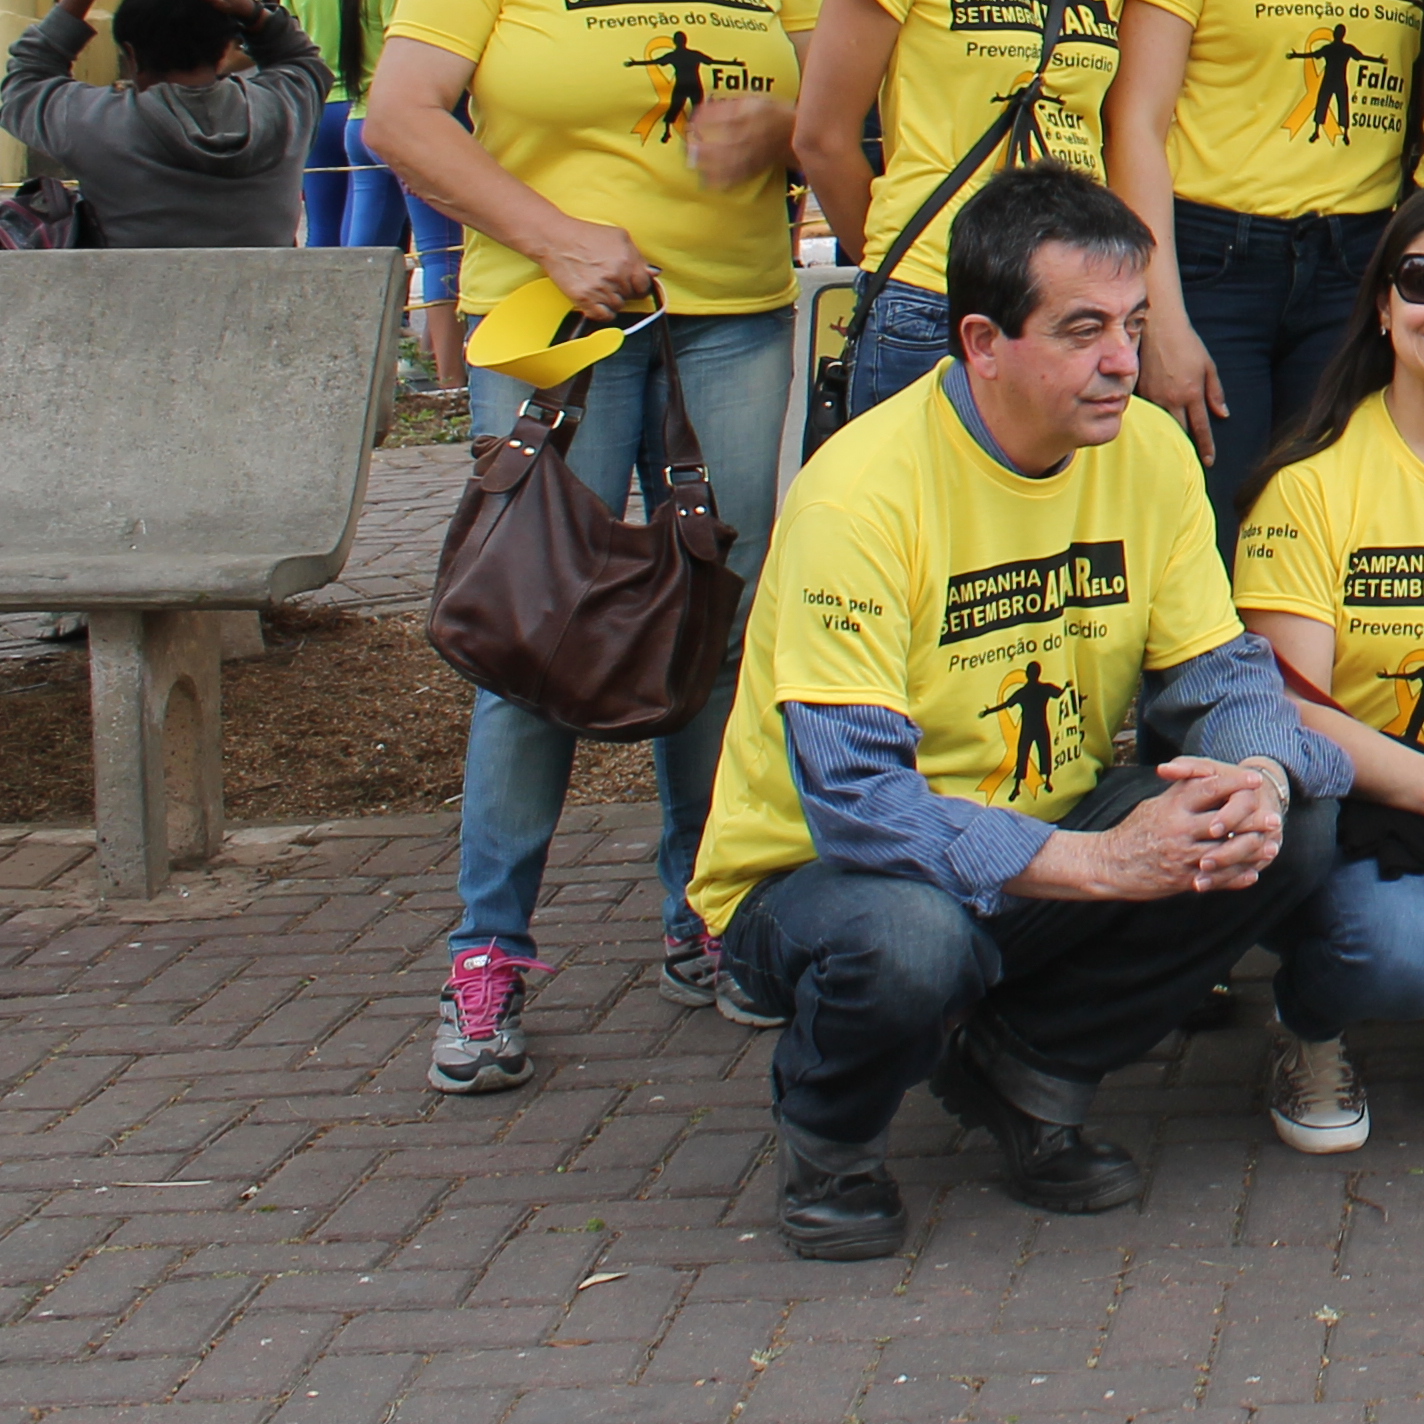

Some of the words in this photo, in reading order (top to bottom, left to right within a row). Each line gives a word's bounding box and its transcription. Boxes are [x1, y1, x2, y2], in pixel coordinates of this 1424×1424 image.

[586, 12, 680, 30] Prevenção
[684, 11, 707, 26] do
[711, 12, 768, 32] Suicídio
[1255, 2, 1344, 20] Prevenção
[1349, 3, 1370, 19] do
[1052, 52, 1114, 73] Suicídio
[711, 68, 775, 93] Falar
[1267, 522, 1298, 540] pela
[1247, 543, 1274, 559] Vida
[803, 588, 842, 607] Todos
[849, 598, 883, 616] pela
[822, 613, 861, 632] Vida
[949, 638, 1037, 672] Prevenção
[1043, 634, 1062, 651] do
